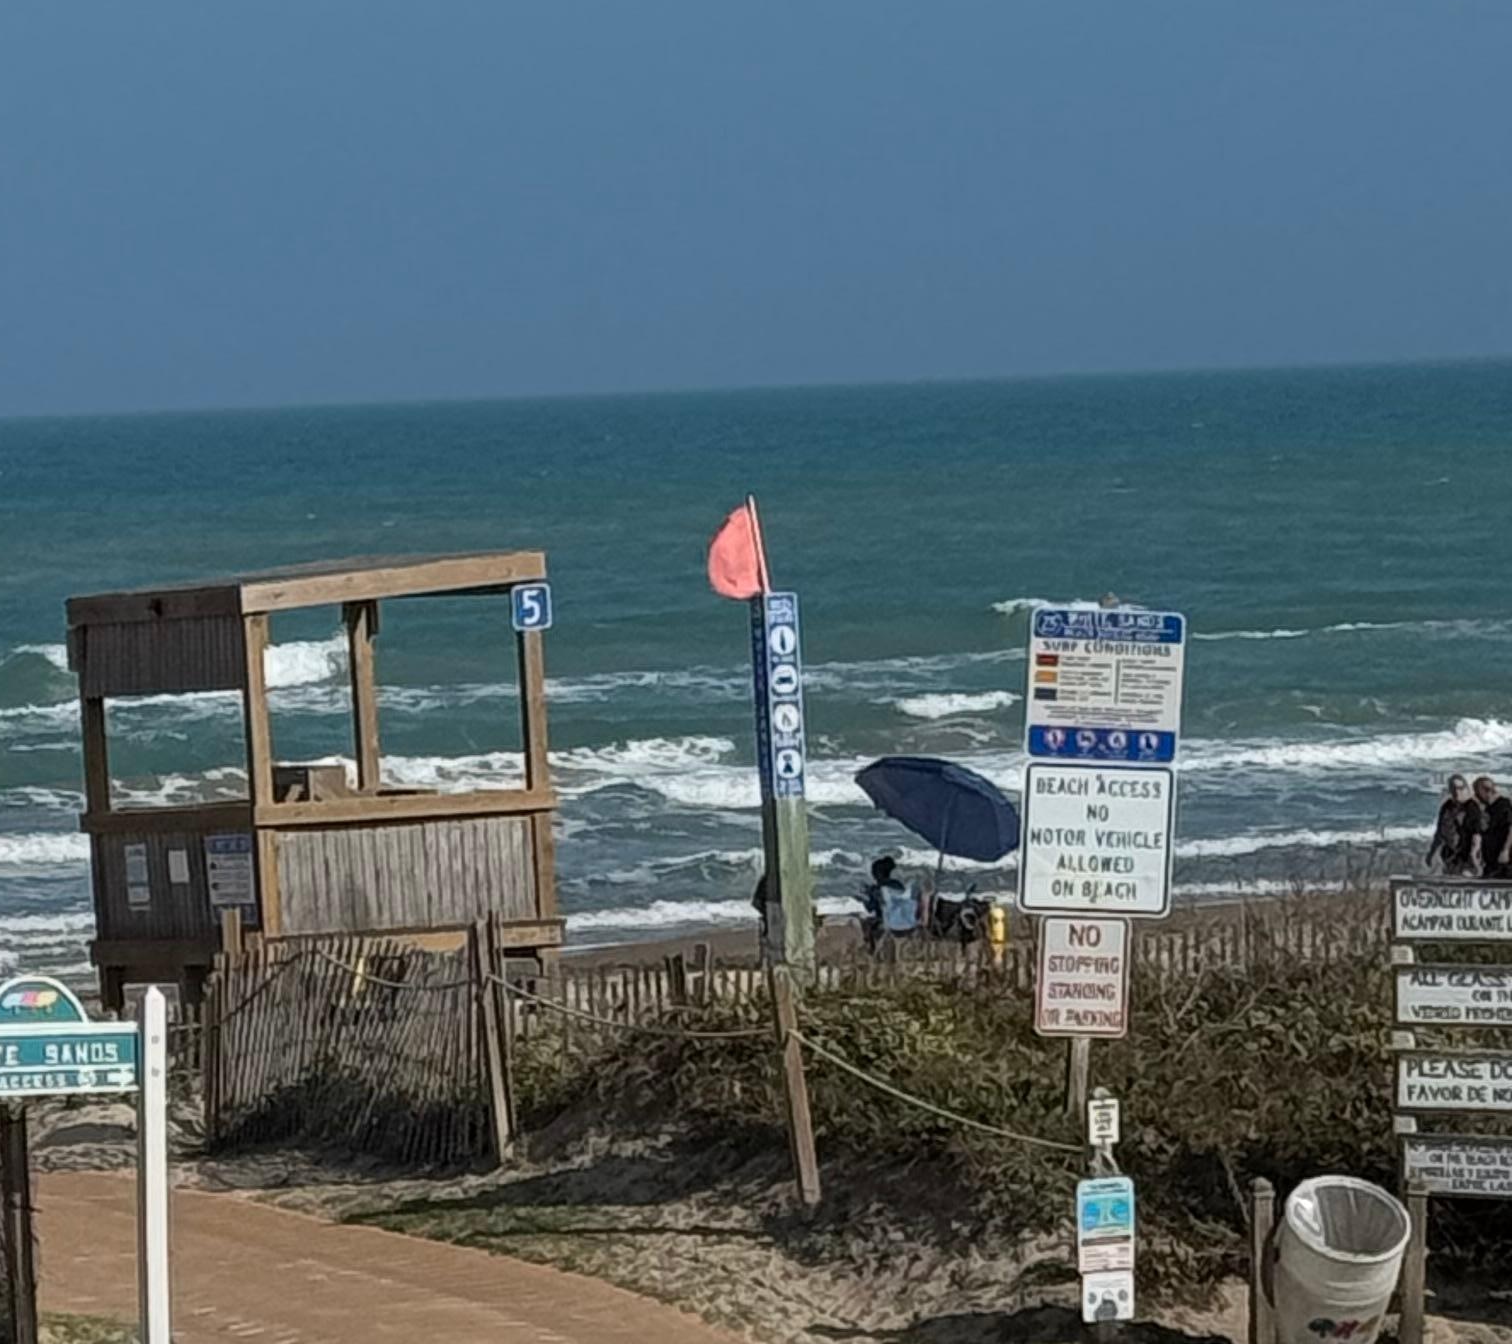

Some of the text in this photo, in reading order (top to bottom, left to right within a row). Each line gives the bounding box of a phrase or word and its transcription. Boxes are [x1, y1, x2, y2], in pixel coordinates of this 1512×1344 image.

[522, 590, 541, 625] 5
[1042, 640, 1078, 652] SURF
[1035, 777, 1162, 798] BEACH ACCESS
[1086, 804, 1110, 822] NO
[1030, 828, 1163, 849] MOTOR VEHICLE
[1056, 854, 1134, 873] ALLOWED
[1051, 880, 1137, 901] ON BEACH
[1068, 924, 1101, 947] NO
[1048, 955, 1119, 974] STOPPING
[45, 1043, 119, 1065] SANDS
[1406, 1058, 1483, 1079] PLEASE
[1406, 1085, 1463, 1102] FAVOR
[1467, 1086, 1487, 1103] DE
